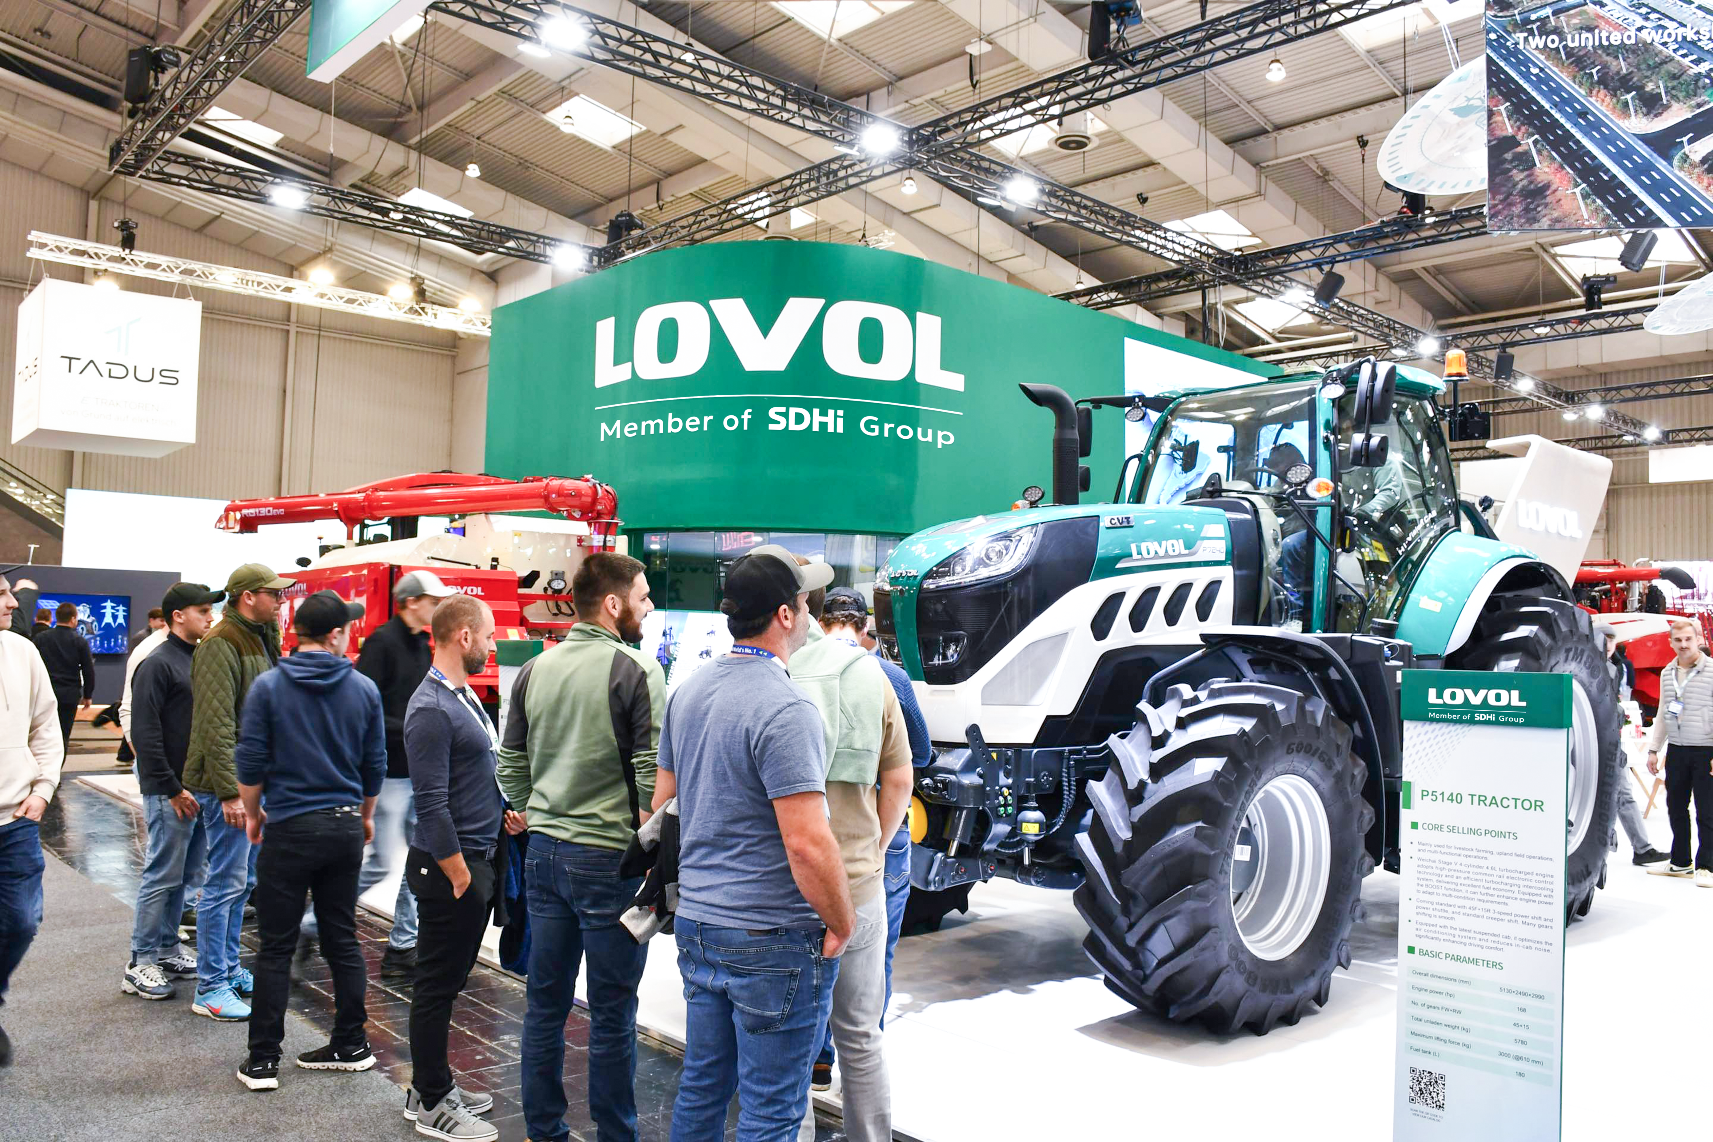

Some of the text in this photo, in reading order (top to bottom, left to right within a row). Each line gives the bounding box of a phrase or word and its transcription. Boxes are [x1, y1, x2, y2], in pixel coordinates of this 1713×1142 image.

[1516, 24, 1713, 50] Two united works
[595, 298, 965, 392] LOVOL
[60, 356, 180, 386] TADUS
[600, 406, 955, 448] Member of SDHi Group
[1109, 516, 1131, 526] CVT
[1516, 499, 1582, 538] LOVOL
[1130, 538, 1189, 560] LOVOL
[1428, 688, 1526, 706] LOVOL
[1429, 712, 1460, 720] Member
[1475, 713, 1495, 721] SDHi
[1499, 715, 1524, 724] Group
[1421, 790, 1545, 812] P5140 TRACTOR
[1422, 822, 1518, 840] CORE SELLING POINTS
[1535, 871, 1554, 879] engine
[1473, 929, 1500, 938] suspended
[1418, 948, 1504, 970] BASIC PARAMETERS
[1411, 985, 1428, 993] Engine
